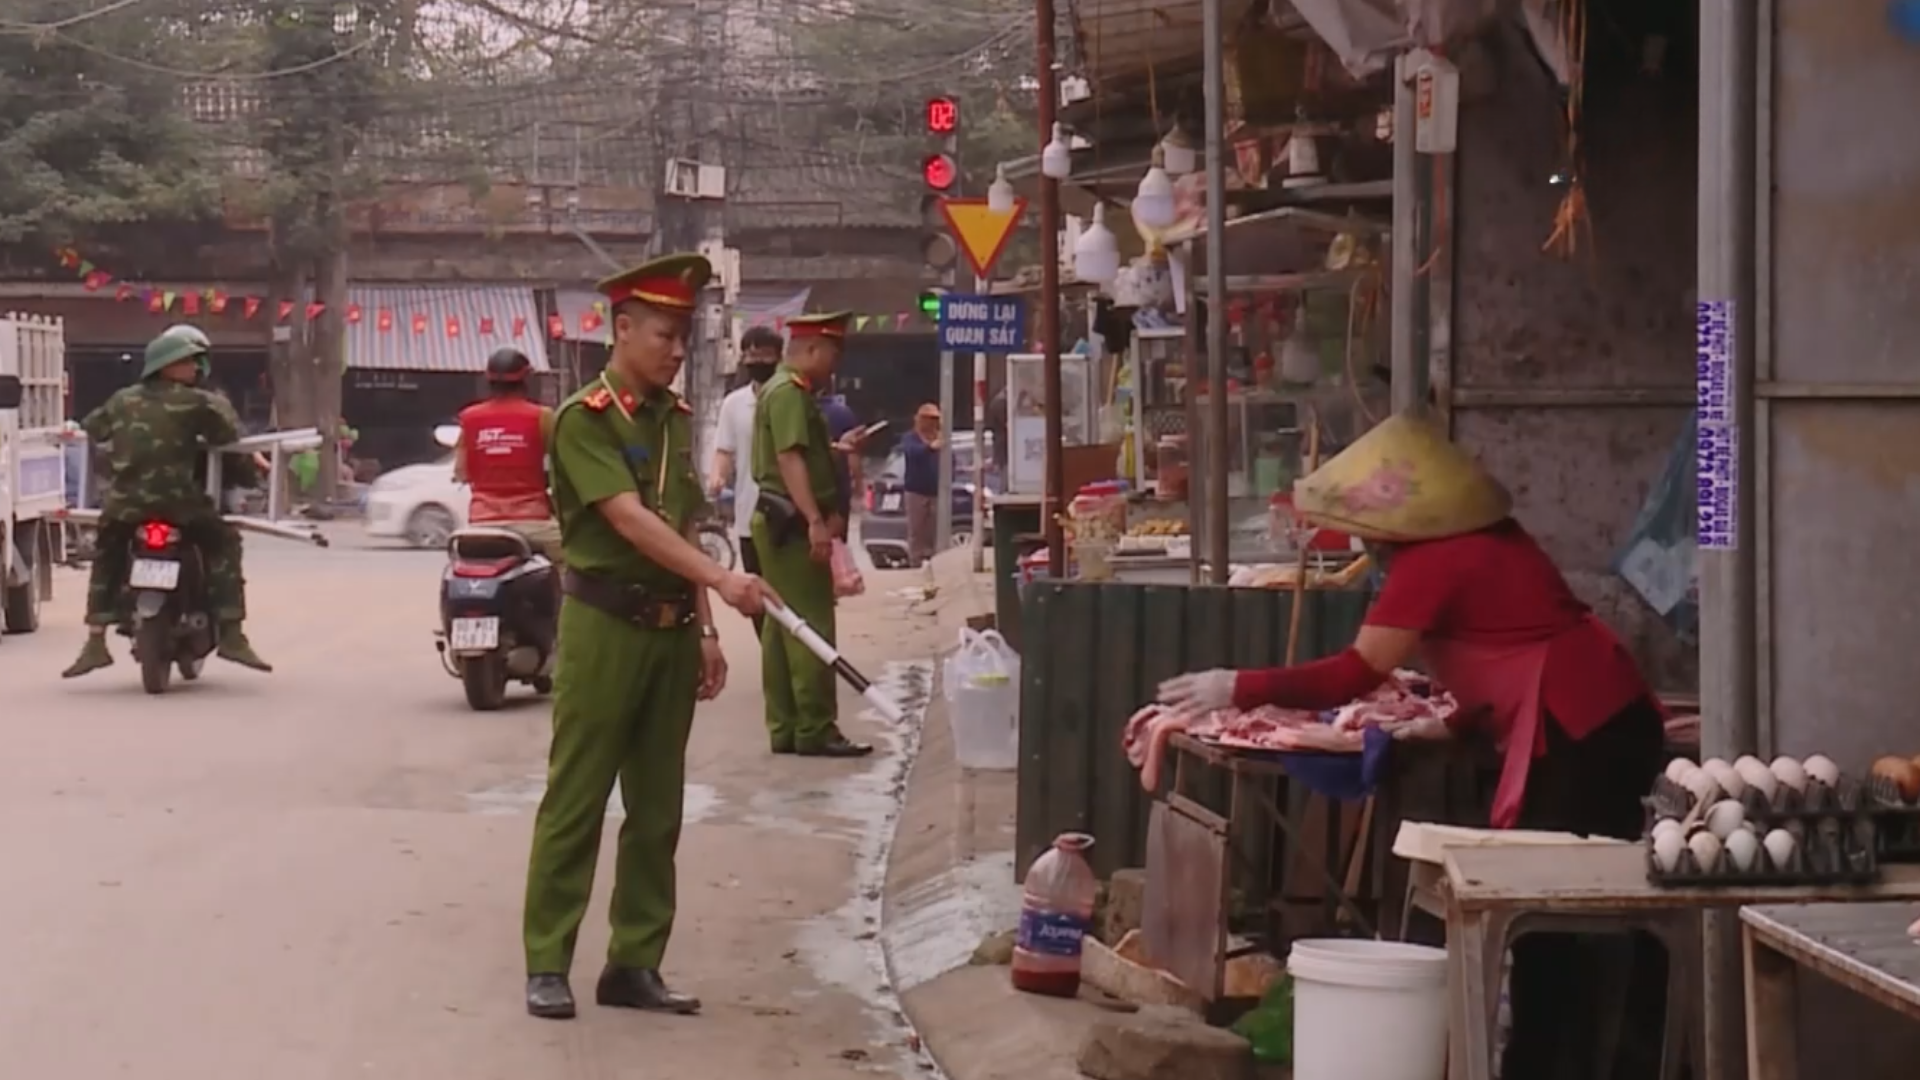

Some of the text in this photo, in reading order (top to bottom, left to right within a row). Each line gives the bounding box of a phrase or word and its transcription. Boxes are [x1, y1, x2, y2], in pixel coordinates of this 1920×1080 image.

[948, 299, 988, 321] DỪNG
[946, 324, 1016, 346] QUAN SÁT
